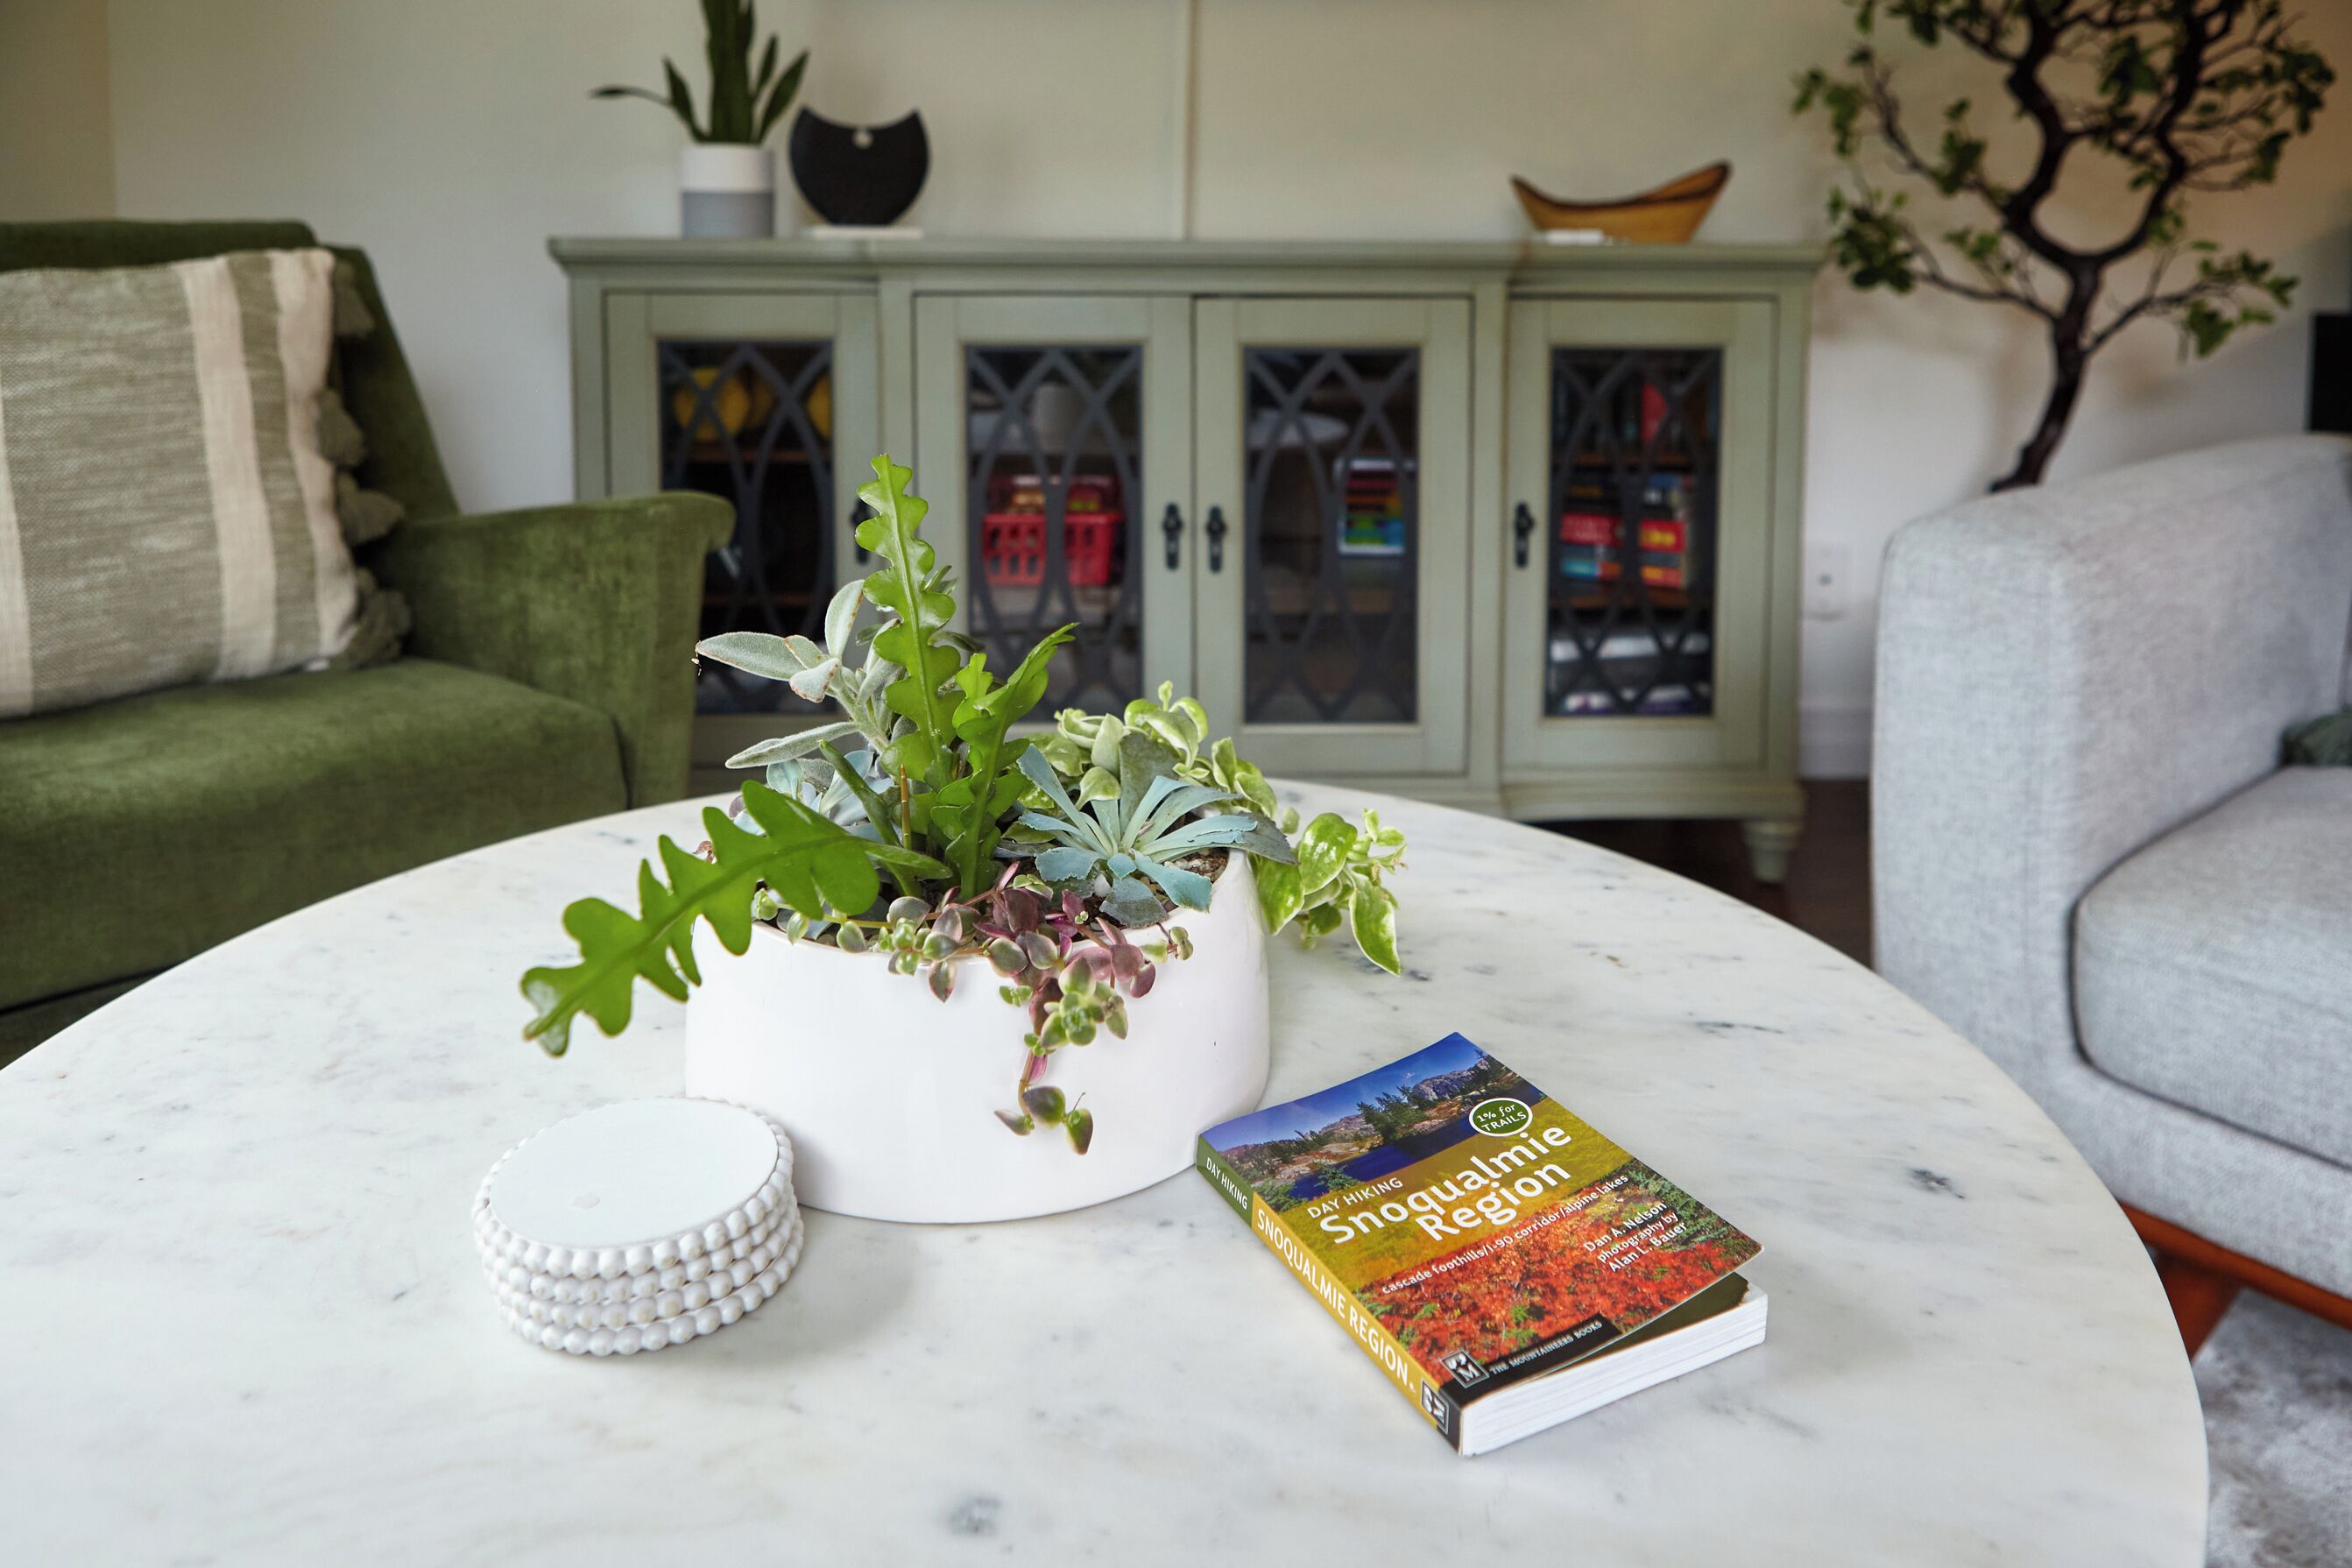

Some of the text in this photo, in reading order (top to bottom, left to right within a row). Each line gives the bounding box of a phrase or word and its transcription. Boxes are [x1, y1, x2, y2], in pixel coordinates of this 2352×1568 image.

[1476, 1104, 1516, 1122] 1% for
[1480, 1111, 1527, 1133] TRAILS
[1207, 1156, 1248, 1211] DAY HIKING
[1306, 1176, 1404, 1219] DAY HIKING
[1319, 1127, 1572, 1244] Snoqualmie
[1415, 1163, 1572, 1241] Region
[1381, 1269, 1433, 1295] cascade
[1596, 1174, 1629, 1196] lakes
[1583, 1201, 1668, 1253] Dan A. Nelson
[1597, 1211, 1679, 1264] photography by
[1608, 1221, 1687, 1273] Alan L. Bauer
[1257, 1208, 1347, 1320] SNOQUALMIE
[1457, 1362, 1481, 1382] M
[1490, 1321, 1603, 1375] THE MOUNTAINEERS BOOKS
